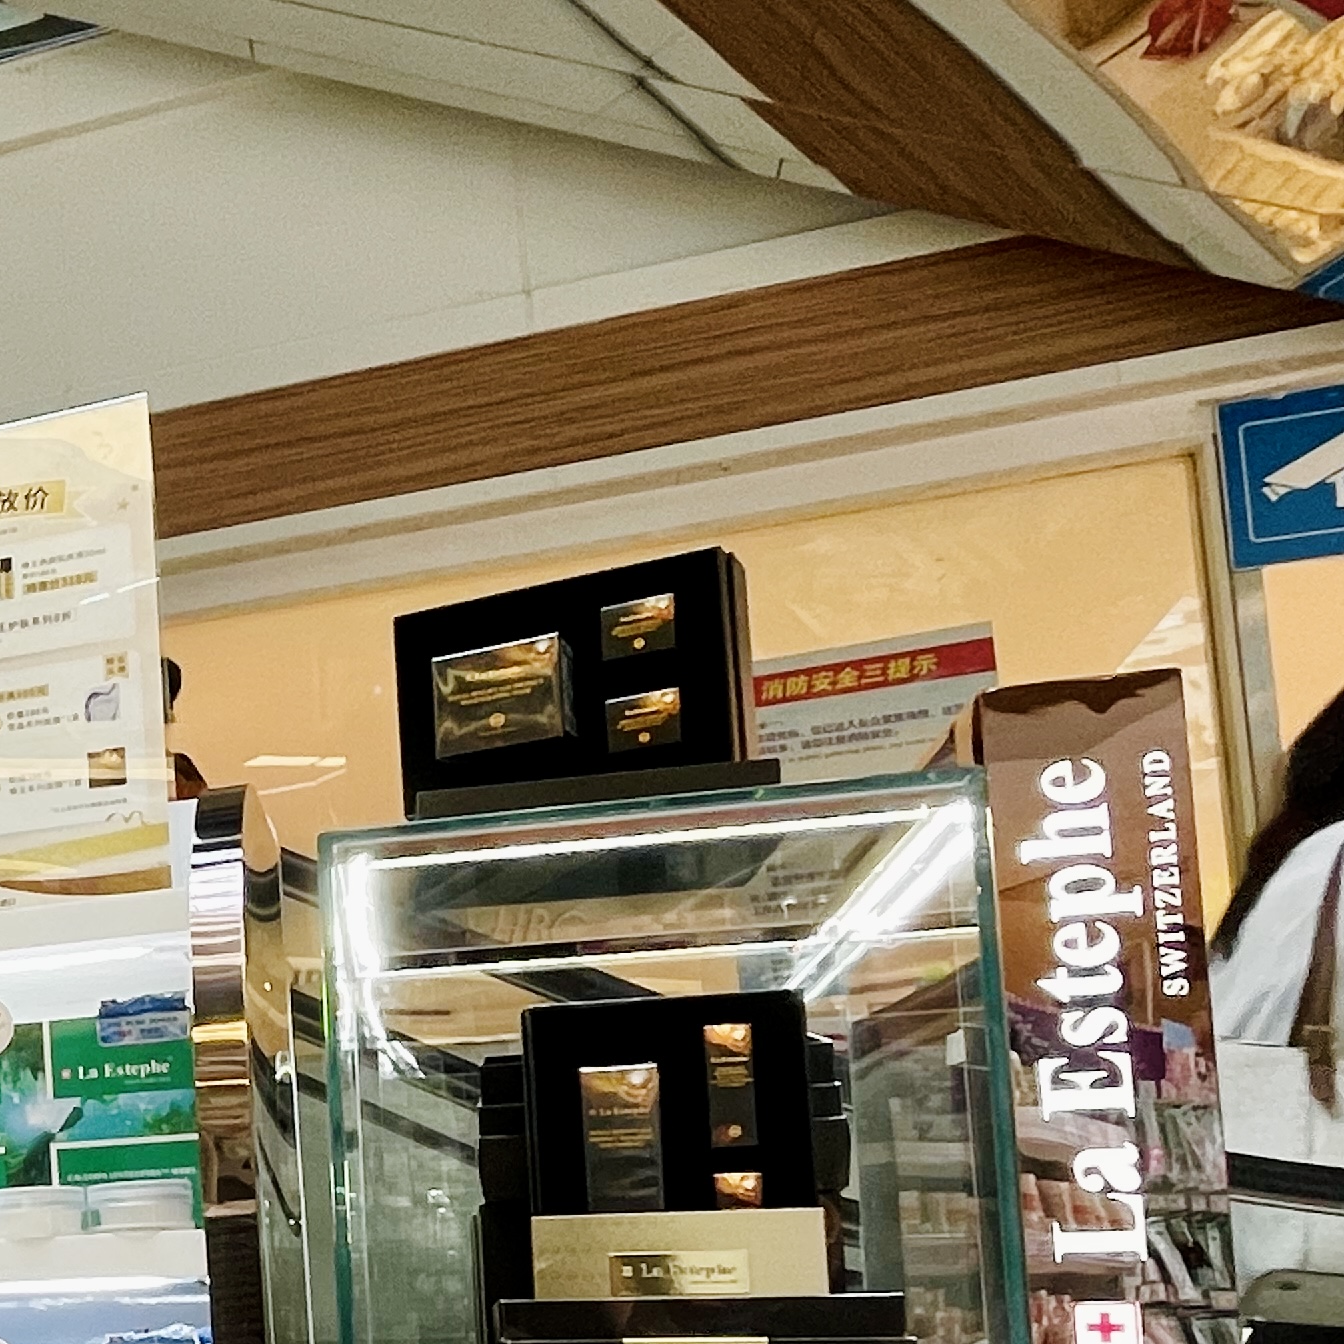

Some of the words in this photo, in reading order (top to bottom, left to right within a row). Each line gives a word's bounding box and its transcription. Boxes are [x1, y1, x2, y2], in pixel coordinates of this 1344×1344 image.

[762, 653, 939, 700] 消防安全三提示
[1141, 748, 1191, 998] SWITZERLAND
[1019, 755, 1142, 1122] Estephe
[77, 1065, 99, 1081] La
[104, 1059, 171, 1080] Estephe
[1052, 1140, 1150, 1265] La
